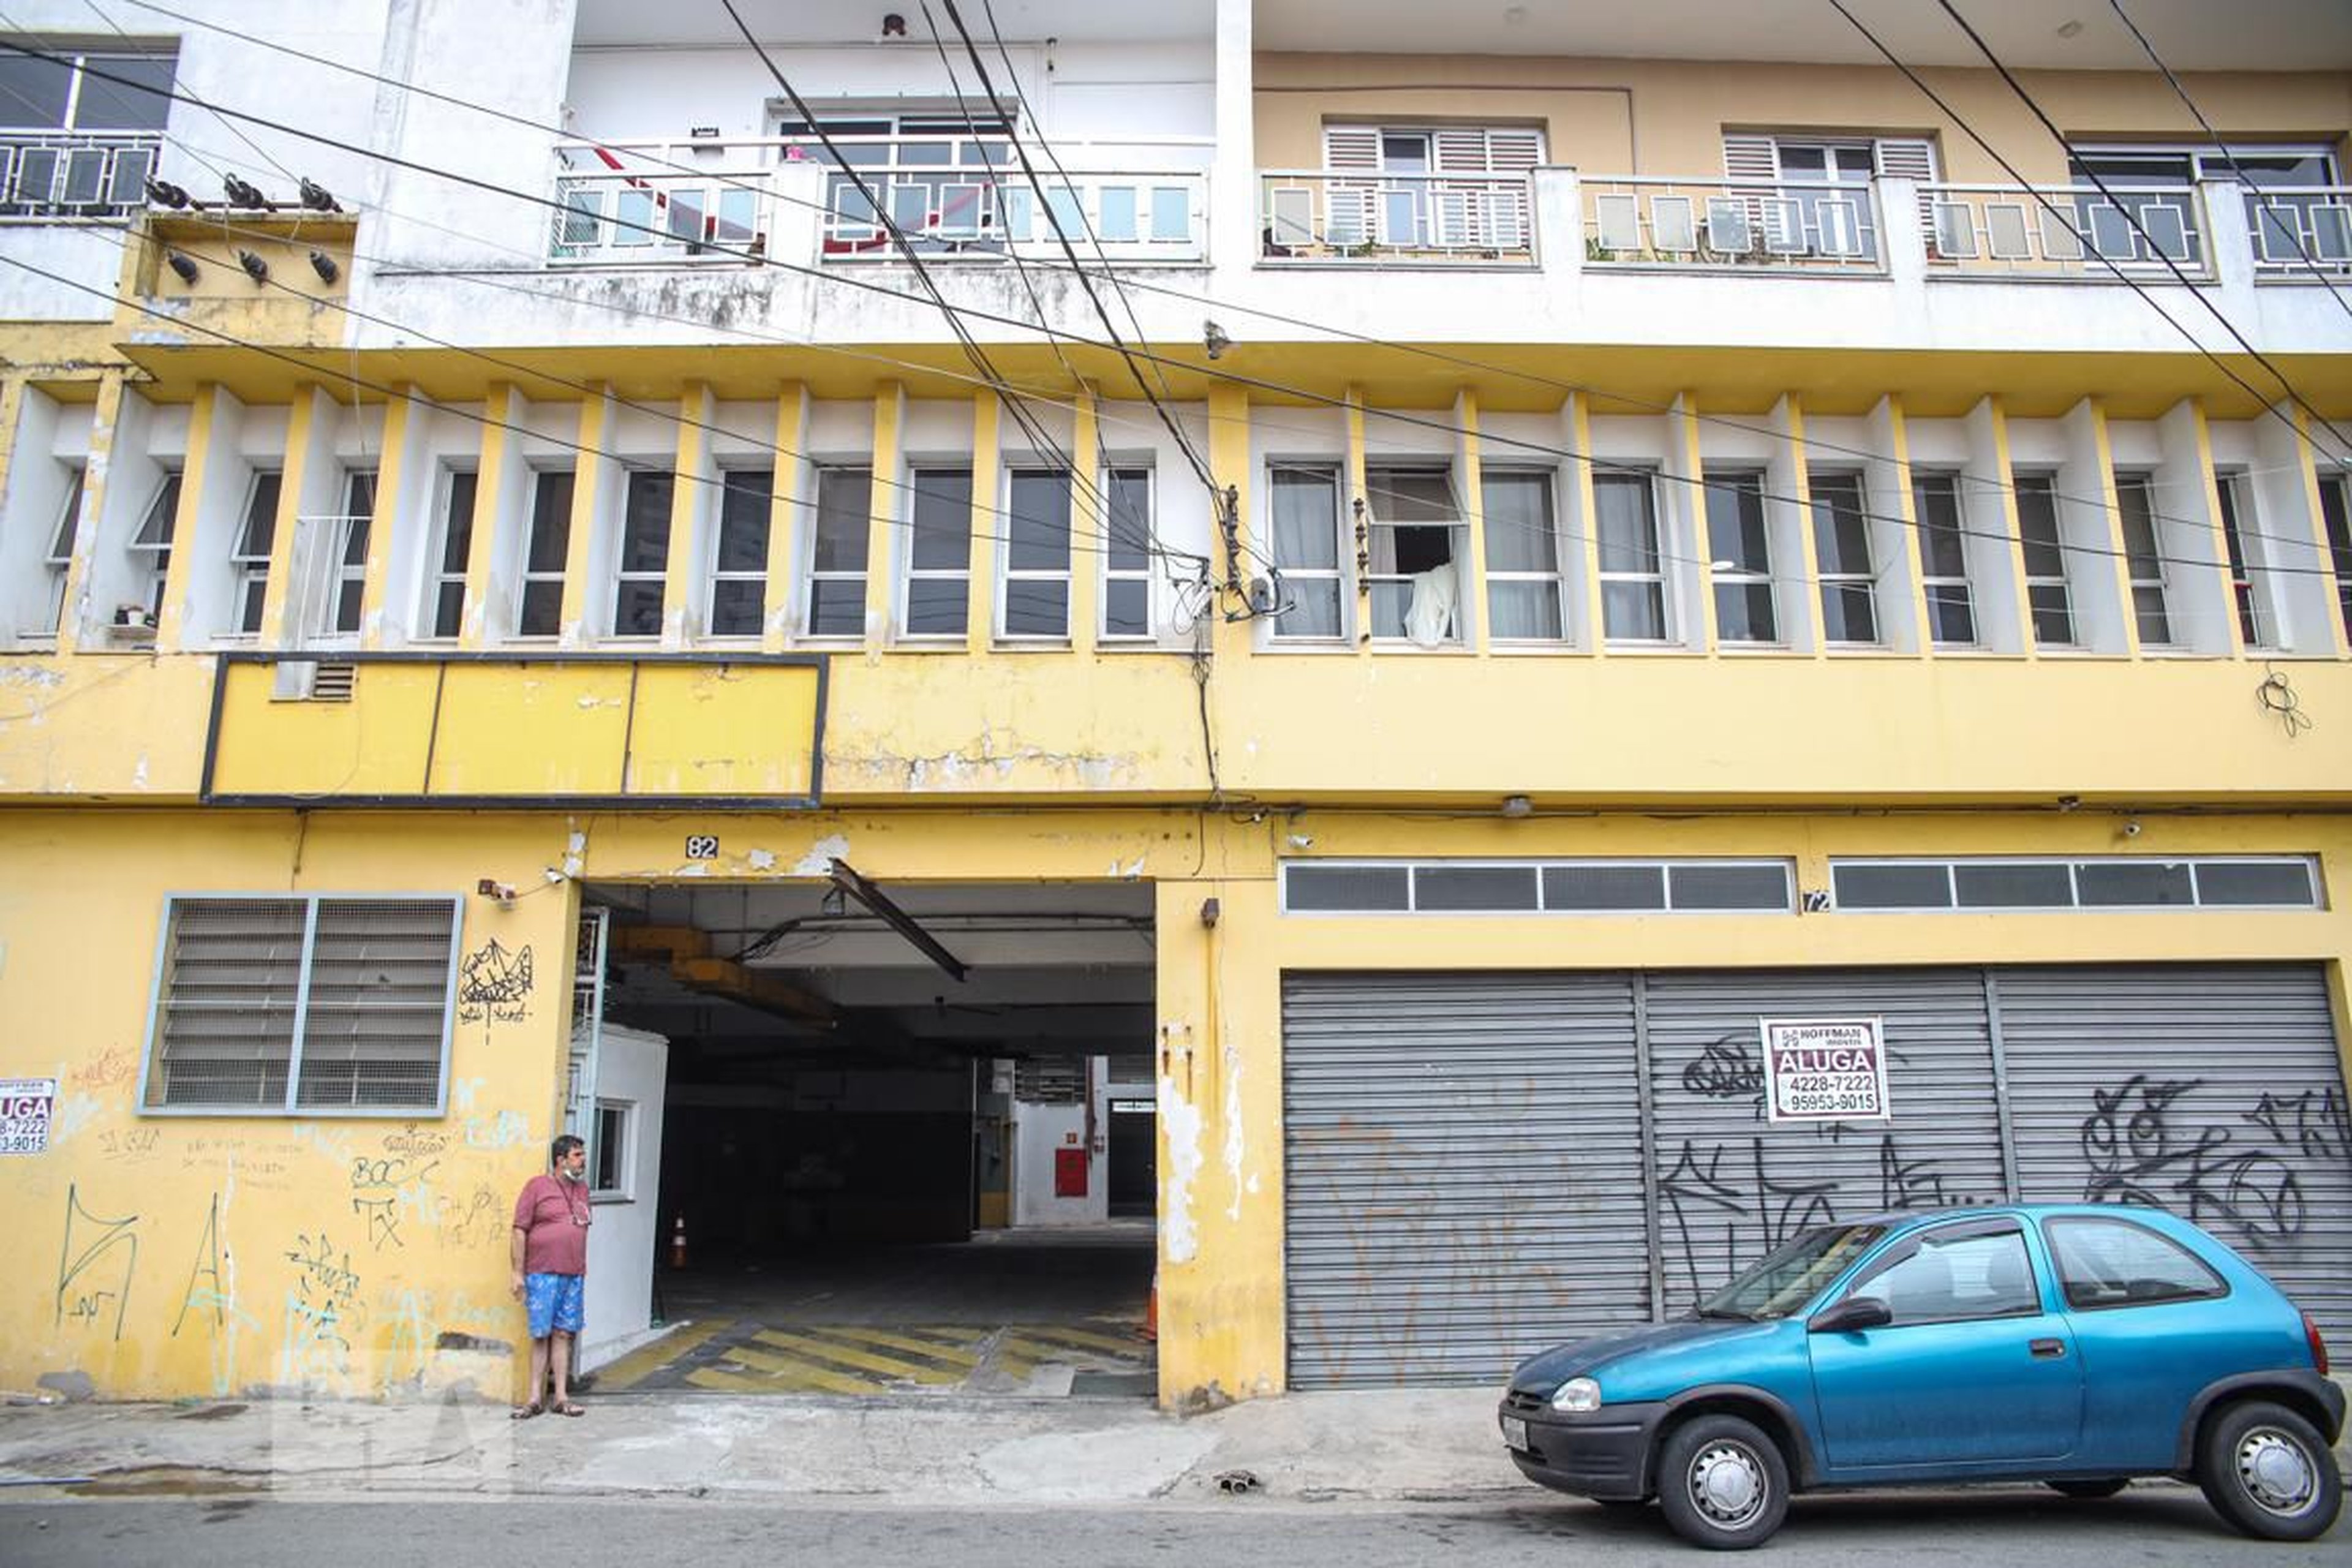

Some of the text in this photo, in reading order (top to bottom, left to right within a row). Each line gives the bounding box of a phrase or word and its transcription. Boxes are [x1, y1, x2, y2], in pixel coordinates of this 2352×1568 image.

[688, 837, 716, 858] 82
[1803, 892, 1830, 913] 72
[1779, 1050, 1871, 1072] ALUGA
[1790, 1076, 1872, 1091] 4228-7222
[1792, 1094, 1874, 1110] 95953-9015
